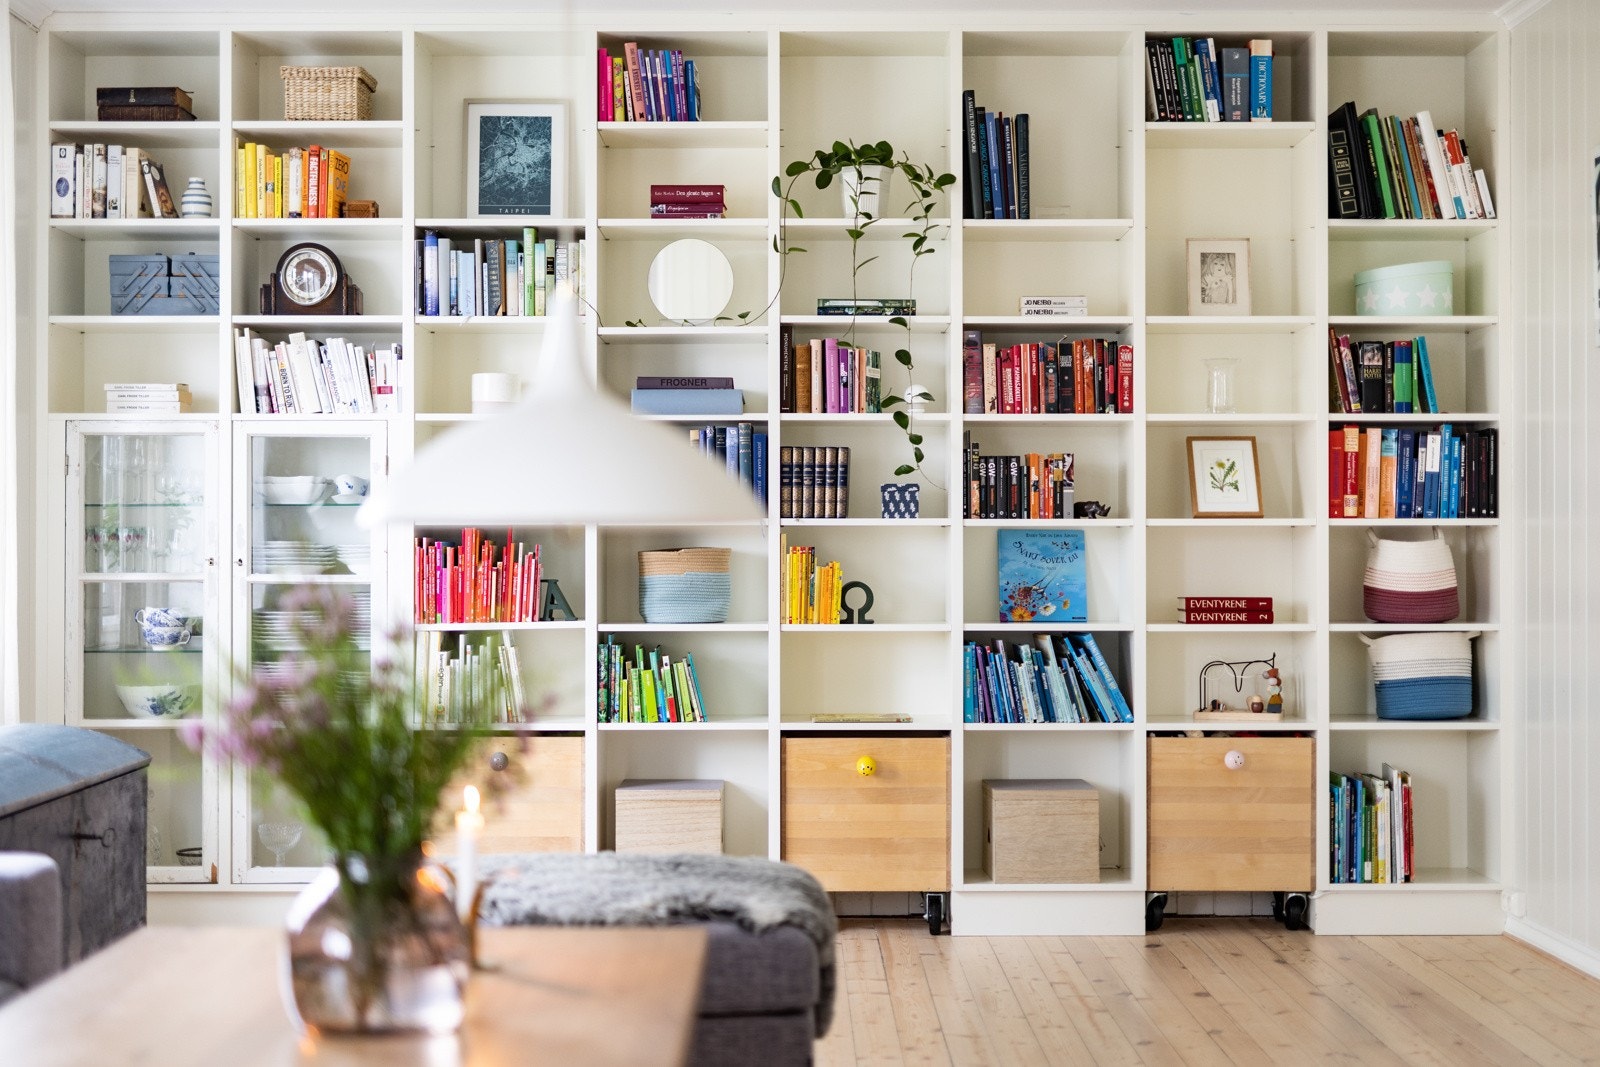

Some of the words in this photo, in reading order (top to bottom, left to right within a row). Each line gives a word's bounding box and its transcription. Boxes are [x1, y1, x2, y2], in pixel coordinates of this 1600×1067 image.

[1258, 61, 1267, 105] DICTIONARY
[309, 157, 318, 206] FACTFULNESS
[327, 360, 336, 380] RICHARD
[331, 381, 341, 403] BRANSON
[980, 463, 986, 477] GW
[988, 462, 996, 477] GW
[1011, 462, 1018, 476] GW
[1013, 541, 1040, 560] SNART
[1068, 553, 1078, 562] DU
[539, 579, 578, 621] A
[1190, 600, 1247, 608] EVENTYRENE
[1191, 613, 1247, 621] EVENTYRENE
